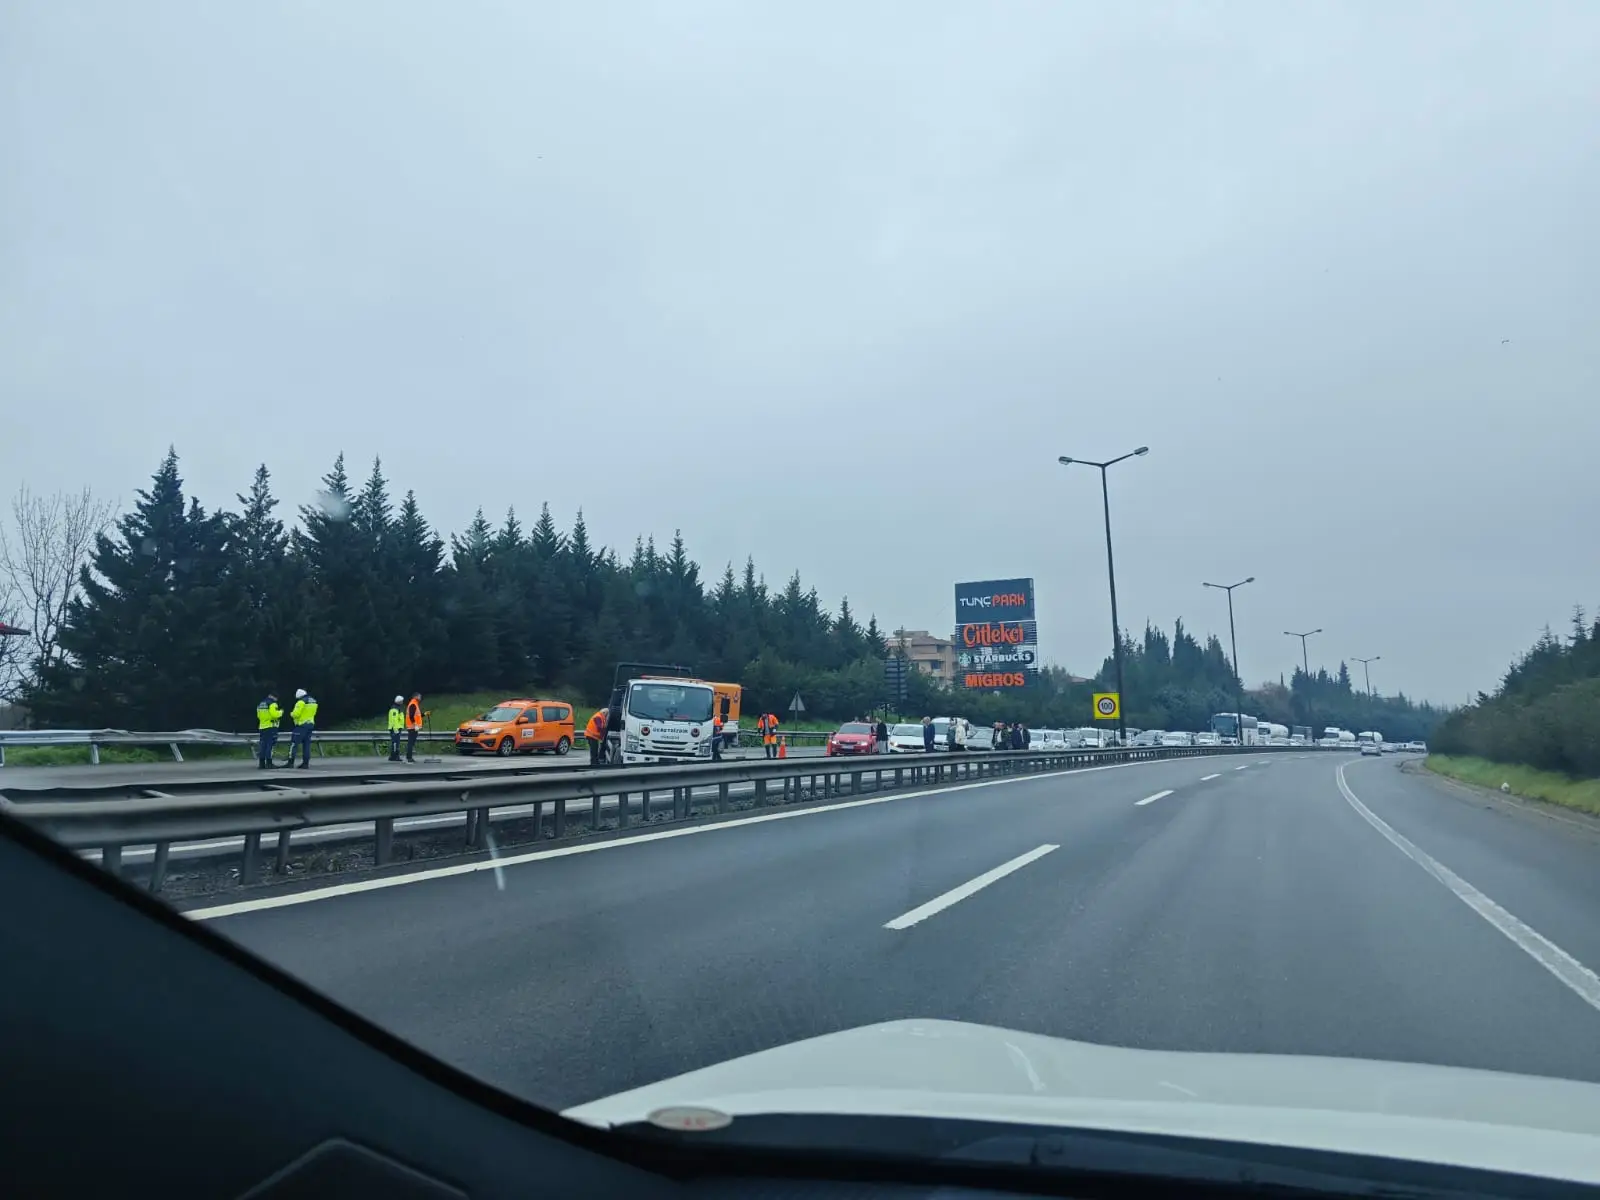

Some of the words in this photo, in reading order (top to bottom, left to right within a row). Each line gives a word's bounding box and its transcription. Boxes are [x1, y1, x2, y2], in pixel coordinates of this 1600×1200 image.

[973, 653, 1031, 663] STARBUCKS
[966, 672, 1025, 687] MIGROS
[1101, 702, 1113, 711] 100
